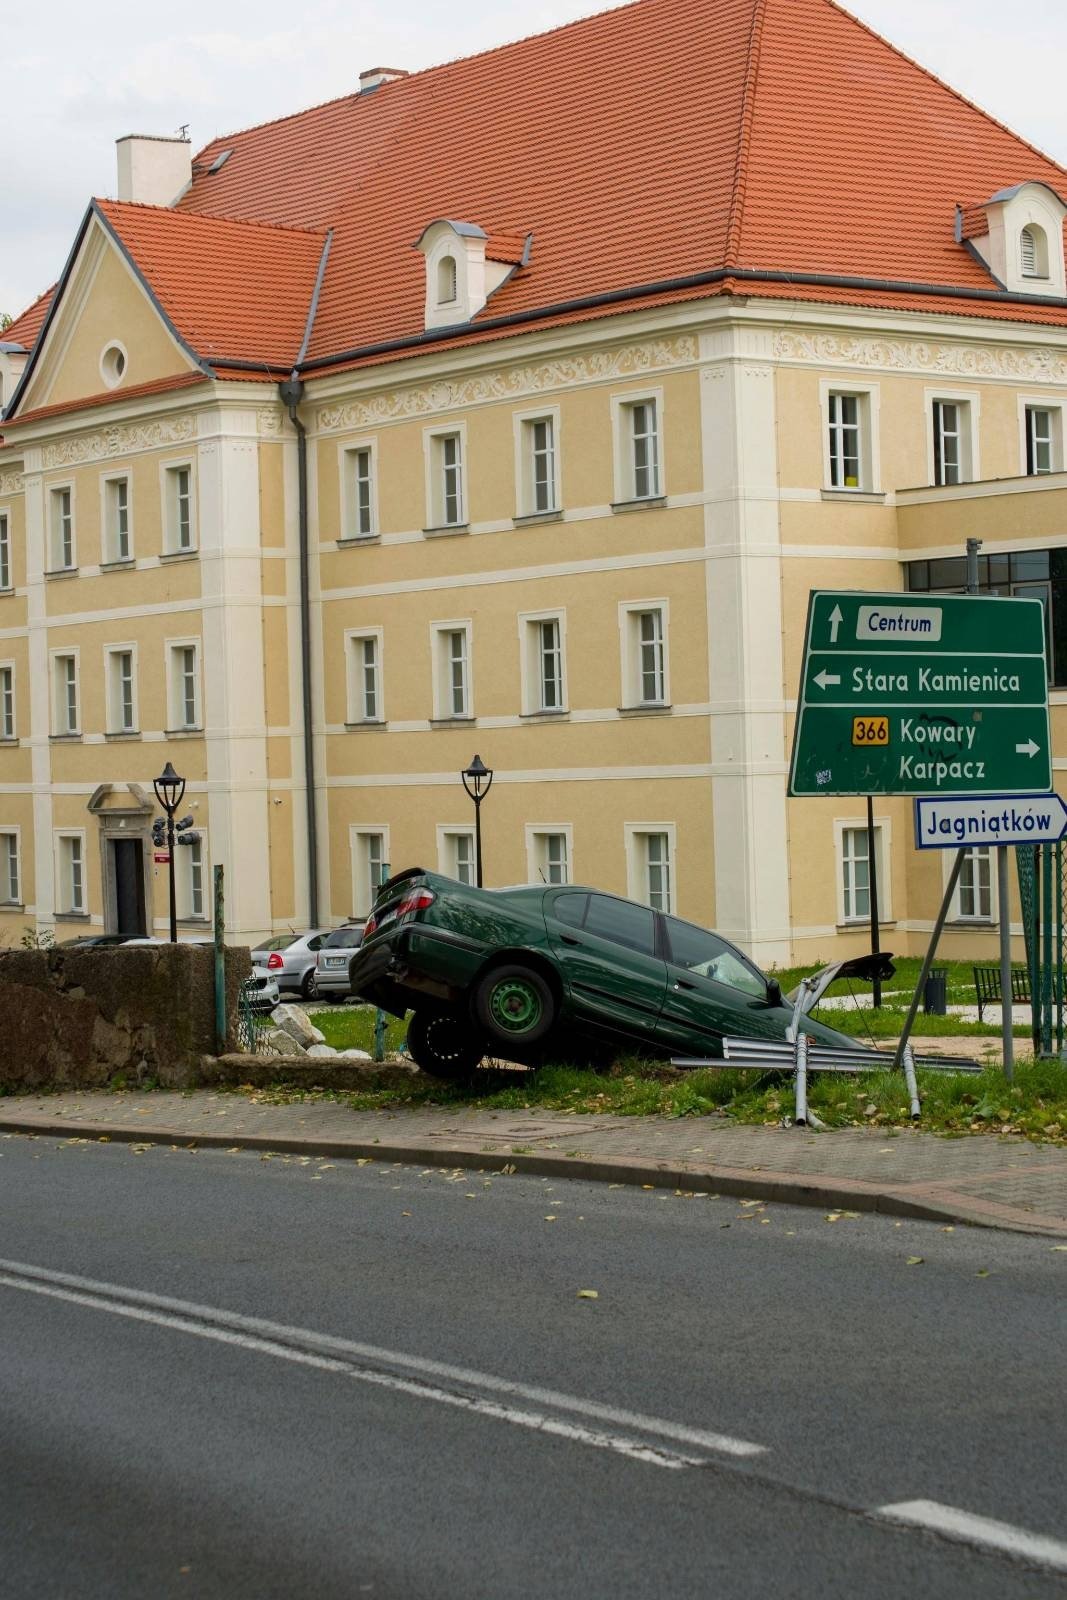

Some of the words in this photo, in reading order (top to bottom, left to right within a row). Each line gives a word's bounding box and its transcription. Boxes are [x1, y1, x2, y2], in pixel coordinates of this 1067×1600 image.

[868, 612, 931, 632] Centrum
[852, 667, 909, 692] Stara
[918, 667, 1020, 692] Kamienica
[855, 721, 887, 741] 366
[900, 719, 976, 749] Kowary
[900, 756, 985, 785] Karpacz
[927, 808, 1051, 840] Jagniątków
